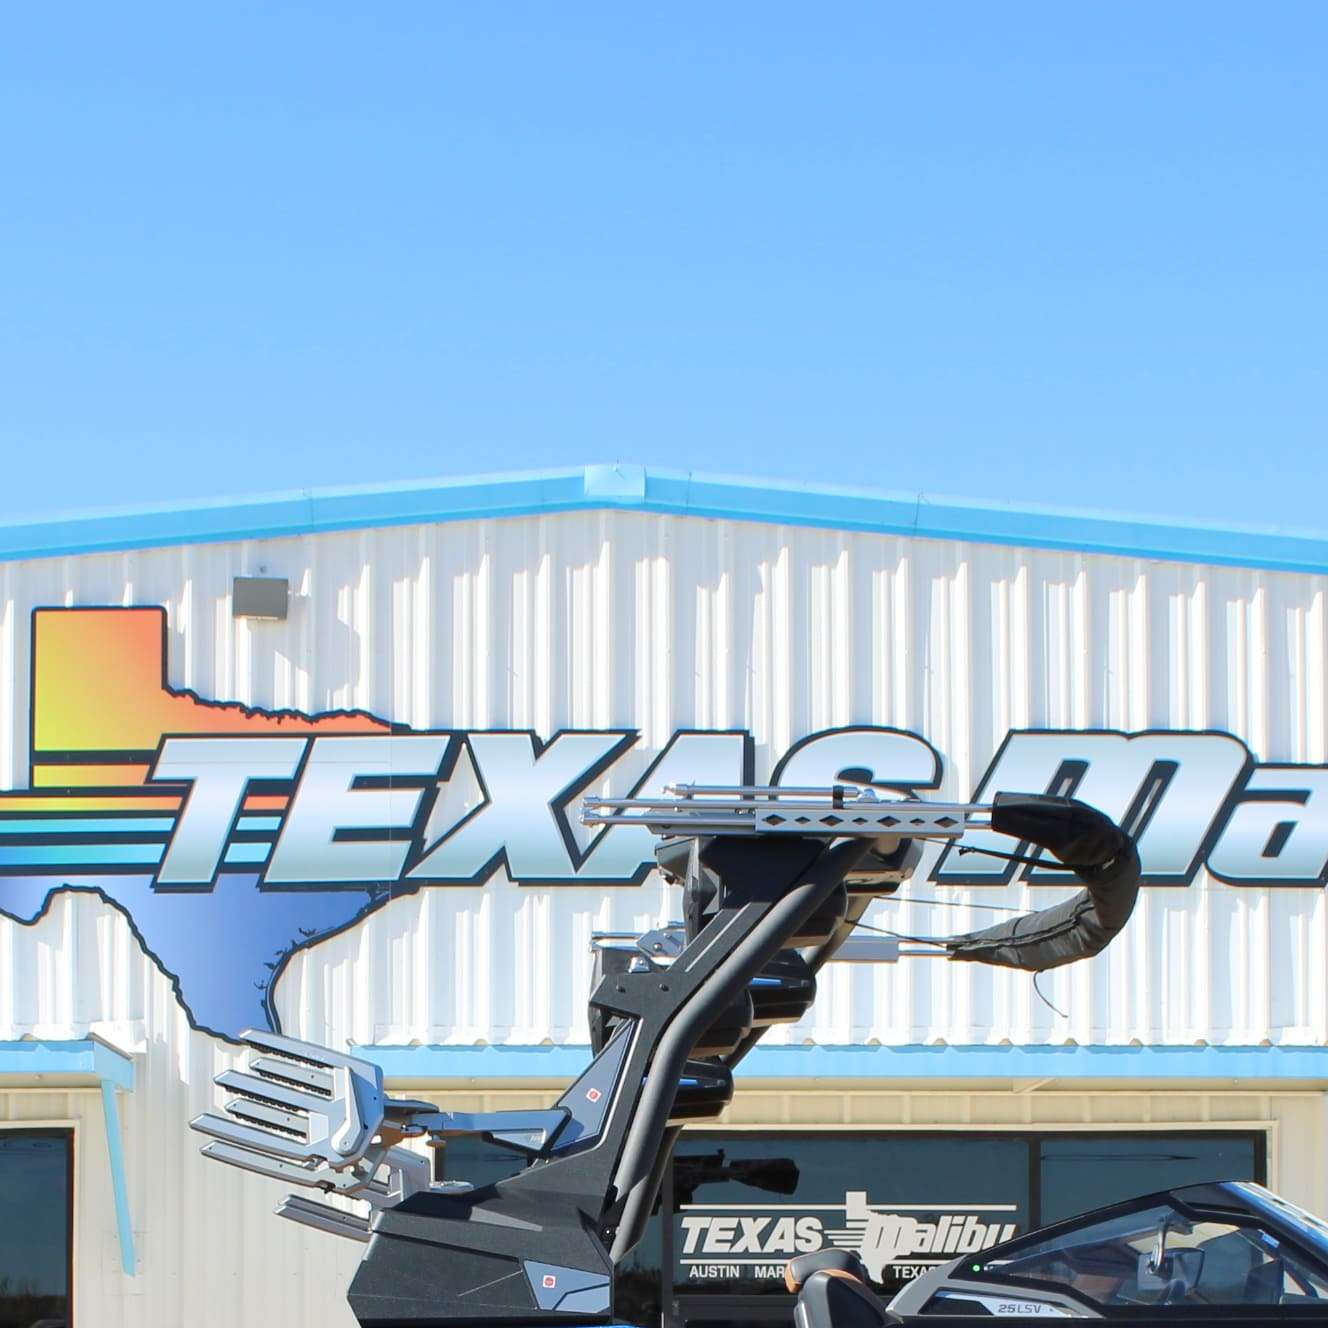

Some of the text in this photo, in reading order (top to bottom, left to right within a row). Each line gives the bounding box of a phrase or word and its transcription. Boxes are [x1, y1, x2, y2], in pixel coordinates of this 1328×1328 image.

[681, 1215, 1017, 1253] TEXAS Malibu
[689, 1265, 740, 1278] AUSTIN
[754, 1265, 786, 1279] MAR
[997, 1303, 1042, 1314] 25LSV
